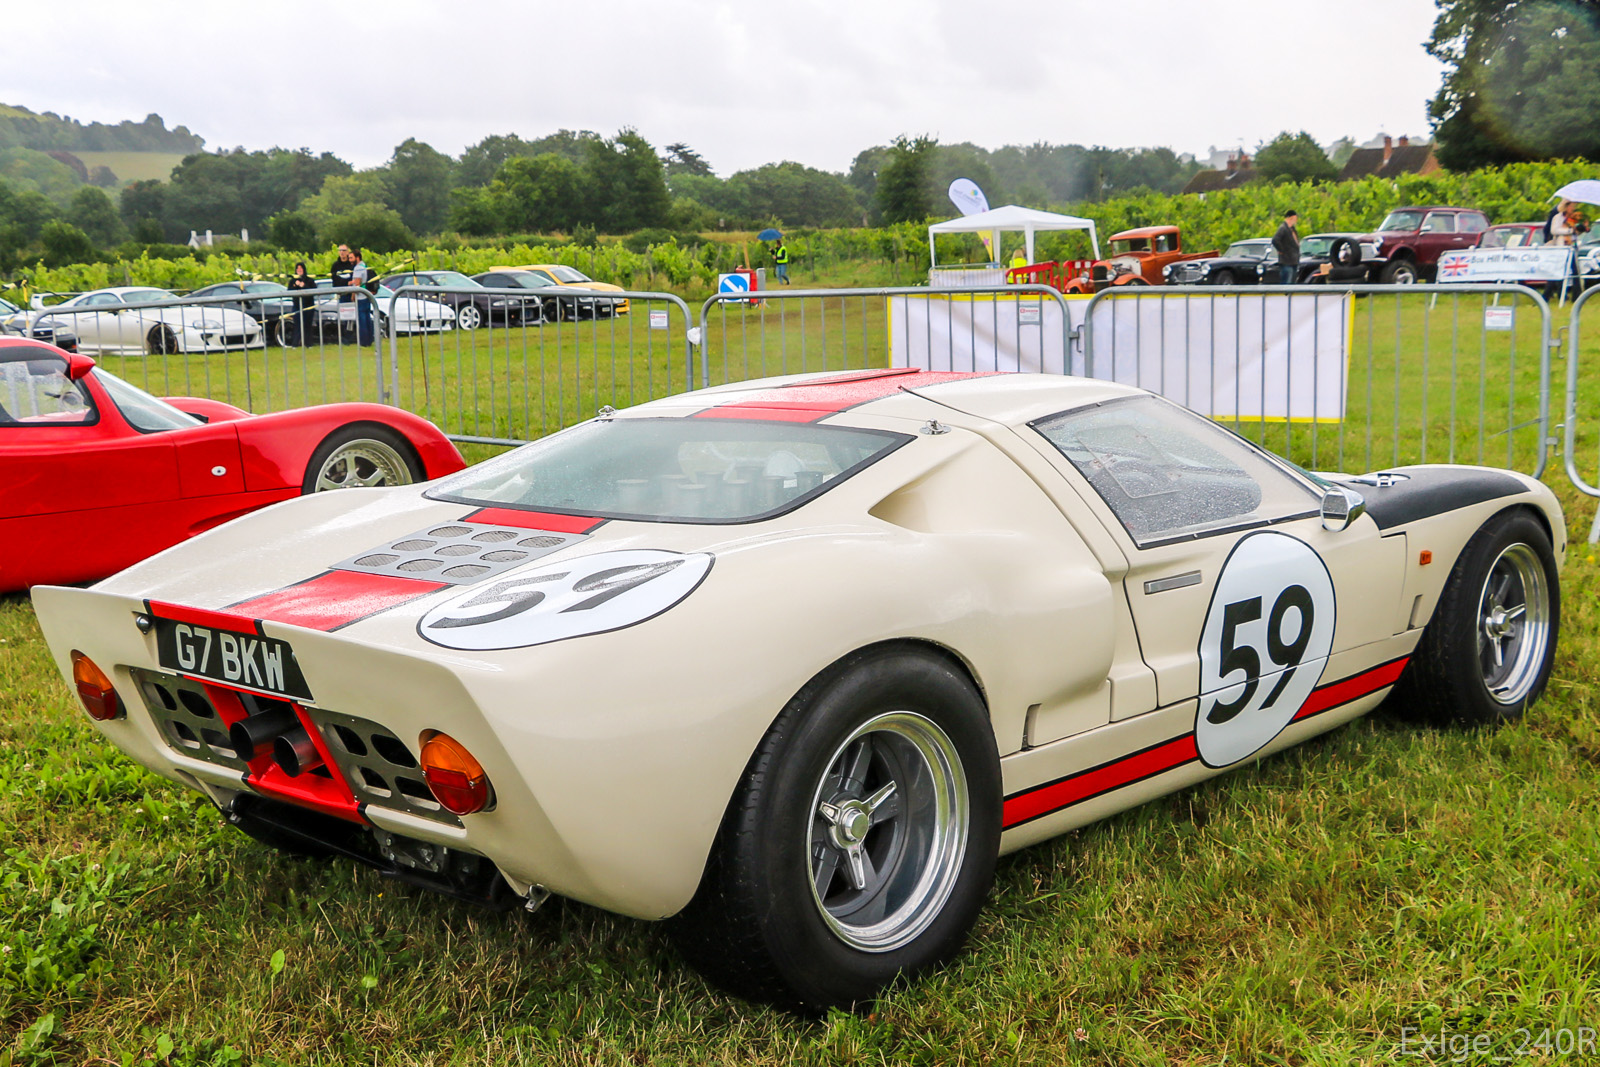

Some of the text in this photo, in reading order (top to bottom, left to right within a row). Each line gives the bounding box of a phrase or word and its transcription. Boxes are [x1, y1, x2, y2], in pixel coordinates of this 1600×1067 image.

[1487, 254, 1500, 262] Hill
[1521, 253, 1540, 261] Club
[427, 559, 685, 629] 59
[175, 623, 285, 692] G7 BKW
[1206, 584, 1314, 725] 59
